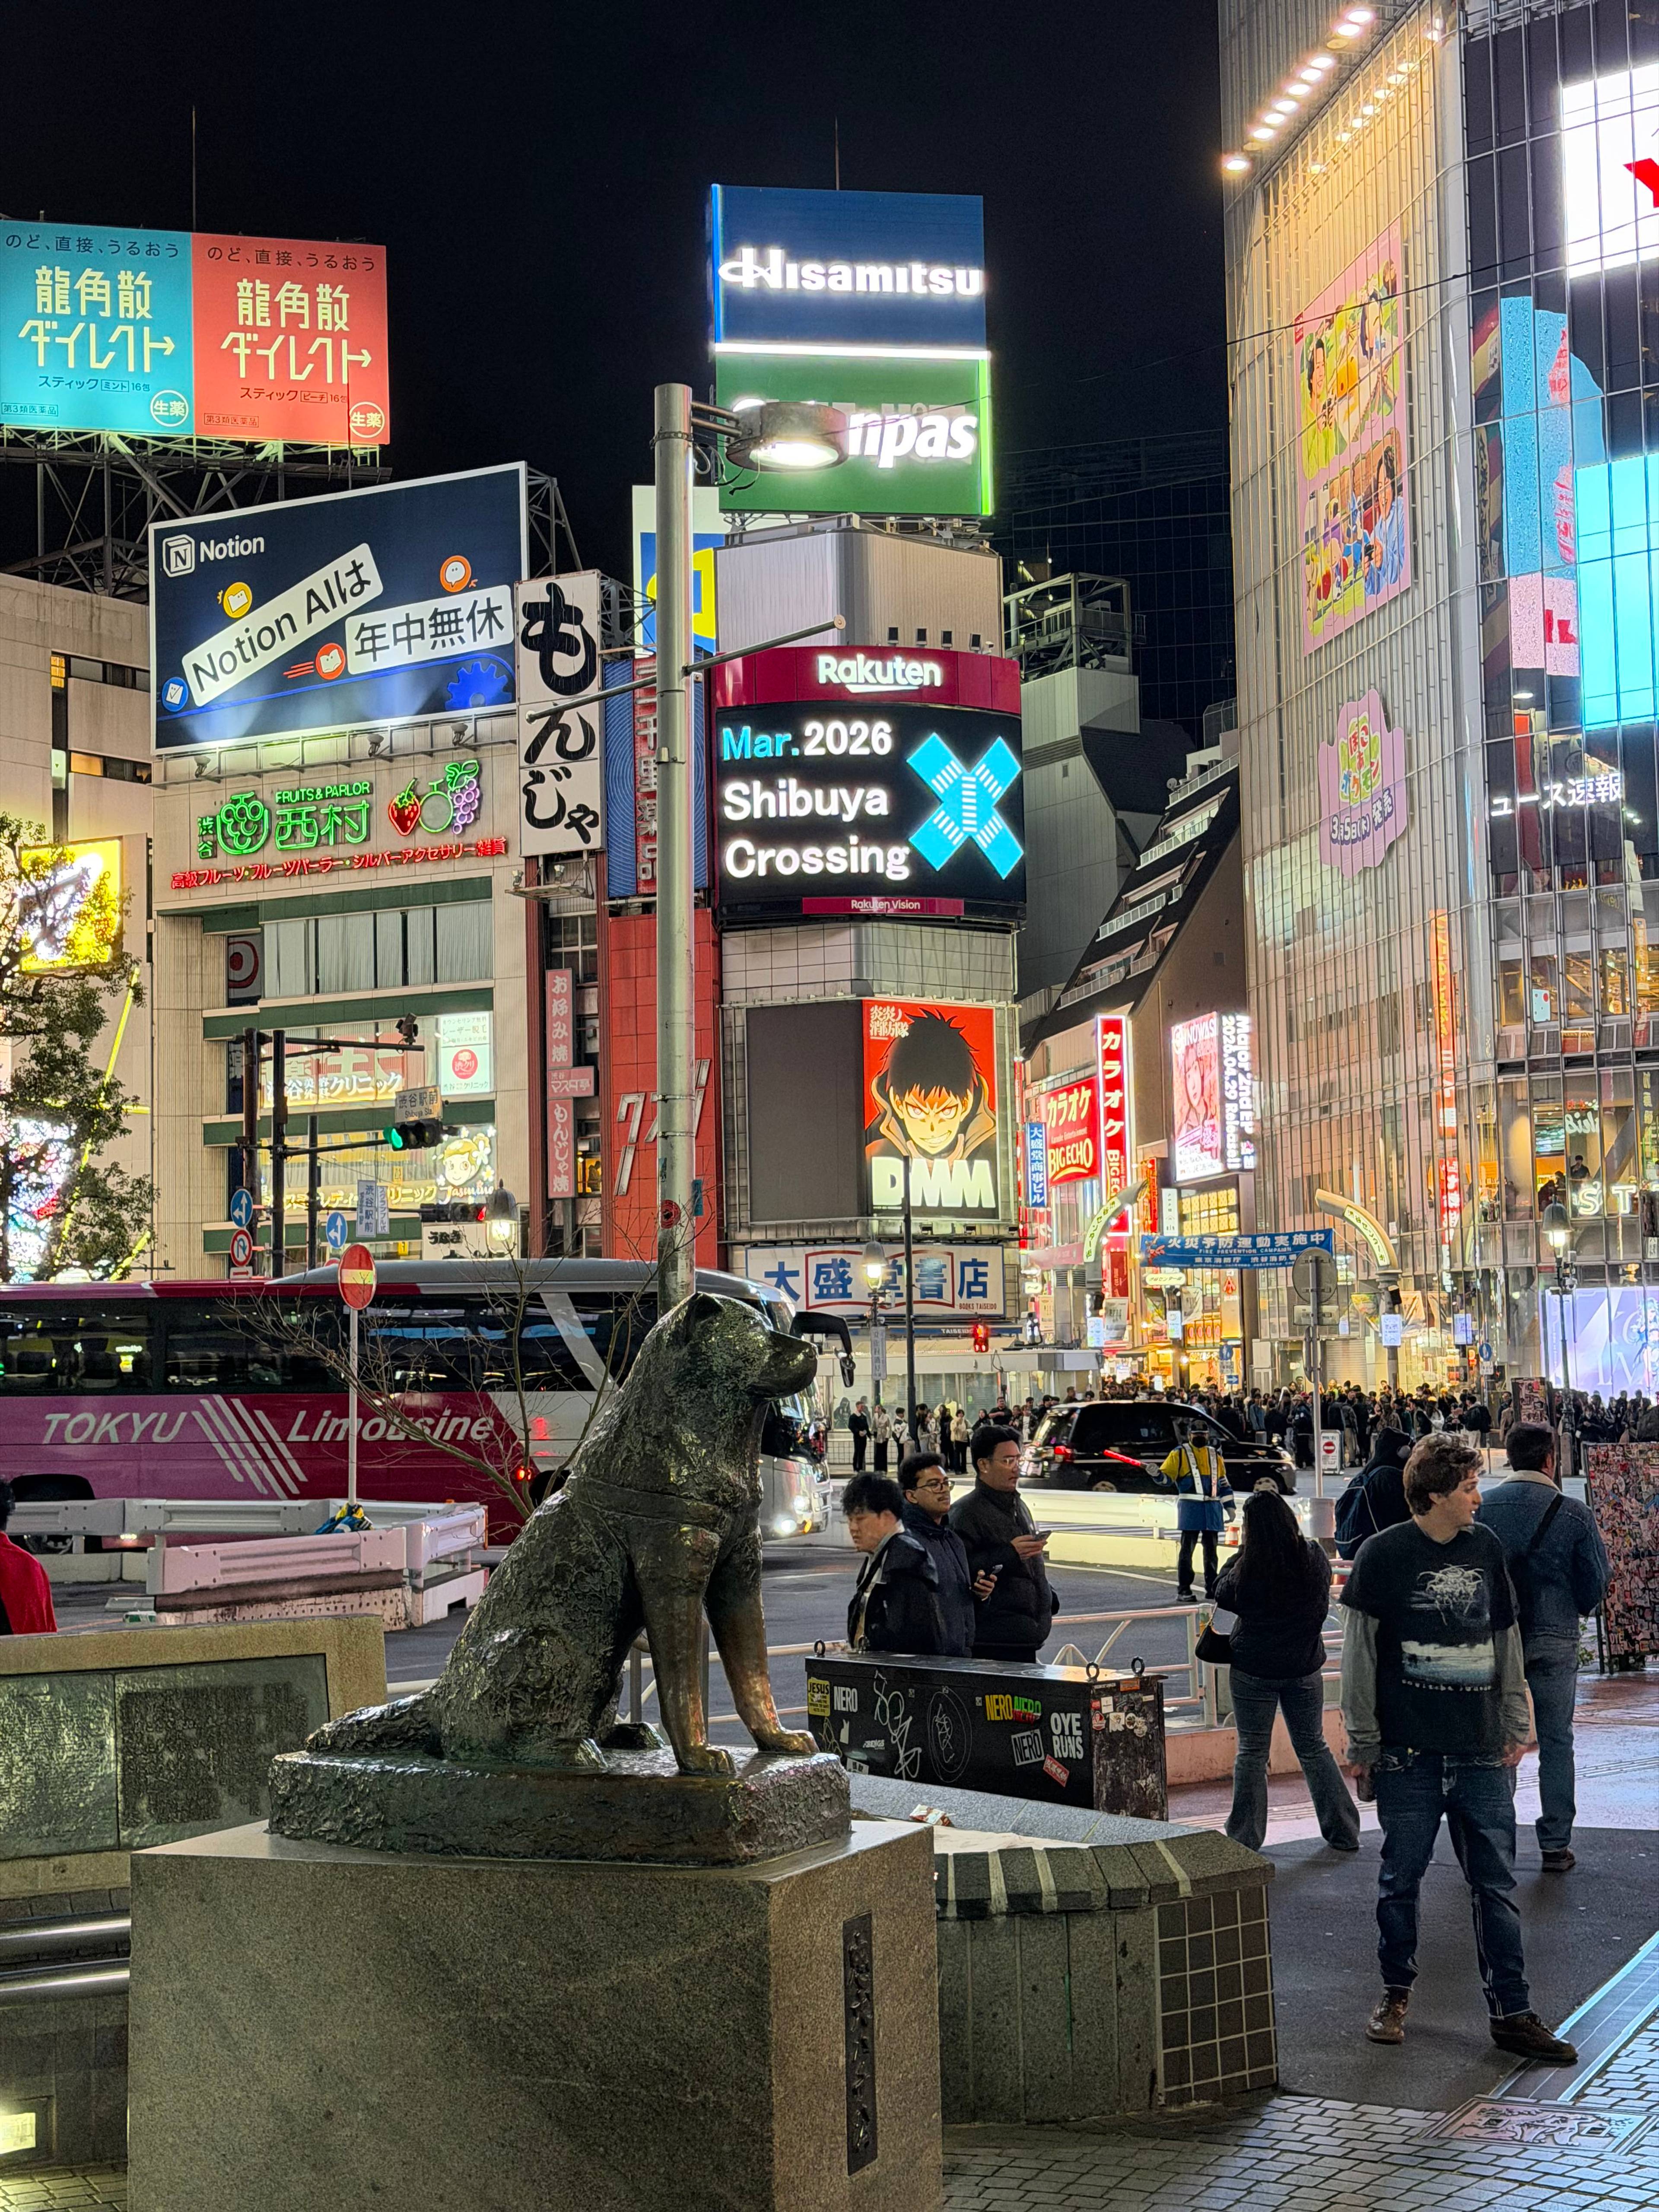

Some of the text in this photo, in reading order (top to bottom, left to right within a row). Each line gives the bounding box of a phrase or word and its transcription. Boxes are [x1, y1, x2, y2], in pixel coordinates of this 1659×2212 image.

[6, 234, 180, 259] のど、直接、うるおう
[207, 246, 375, 272] のど、直接、うるおう
[718, 248, 984, 295] Hisamitsu
[35, 265, 153, 319] 龍角散
[237, 278, 350, 332] 龍角散
[18, 319, 175, 372] ダイレクト
[220, 332, 372, 385] ダイレクト
[38, 375, 150, 392] スティック ミント 16包
[240, 388, 298, 402] スティック
[3, 404, 57, 416] 第3類医薬品
[153, 400, 186, 417] 生薬
[206, 414, 258, 426] 第3類医薬品
[350, 411, 382, 429] 生薬
[200, 535, 264, 563] Notion
[353, 597, 504, 663] 年中無休
[192, 611, 298, 693] Notion
[818, 653, 942, 692] Rakuten
[521, 582, 600, 845] もんじゃ
[275, 788, 315, 804] FRUITS
[325, 781, 370, 798] PARLOR
[724, 779, 889, 822] Shibuya
[1491, 772, 1621, 817] ユース速報
[197, 816, 215, 858] 渋谷
[274, 799, 370, 850] 西村
[725, 835, 911, 881] Crossing
[851, 899, 920, 911] Rakuten Vision
[552, 976, 568, 1062] お好み焼
[870, 1005, 902, 1023] 炎炎ノ
[870, 1020, 909, 1038] 消防隊
[1222, 1015, 1238, 1100] 2026.04.29
[1233, 1015, 1253, 1071] Major
[399, 1089, 438, 1109] 渋谷駅前
[1102, 1032, 1125, 1138] カラオケ
[1047, 1086, 1091, 1128] カラオケ
[1240, 1111, 1254, 1134] EP
[553, 1104, 569, 1192] もんじゃ焼
[1030, 1126, 1045, 1204] 大盛堂商事ビル
[1048, 1138, 1093, 1180] BIG ECHO
[1106, 1149, 1120, 1177] BIG
[872, 1156, 996, 1208] DMM
[365, 1185, 374, 1233] 渋谷駅前
[428, 1230, 462, 1245] うなぎ
[1167, 1232, 1325, 1249] 火災予防運動実施中
[764, 1257, 988, 1301] 大盛堂書店
[42, 1411, 188, 1445] TOKYU
[286, 1408, 496, 1443] Limousine
[809, 1682, 830, 1695] JESUS
[833, 1686, 858, 1713] NERO
[985, 1694, 1013, 1721] NERO
[1050, 1712, 1082, 1736] OYE
[1013, 1732, 1043, 1764] NERO
[1052, 1735, 1084, 1760] RUNS
